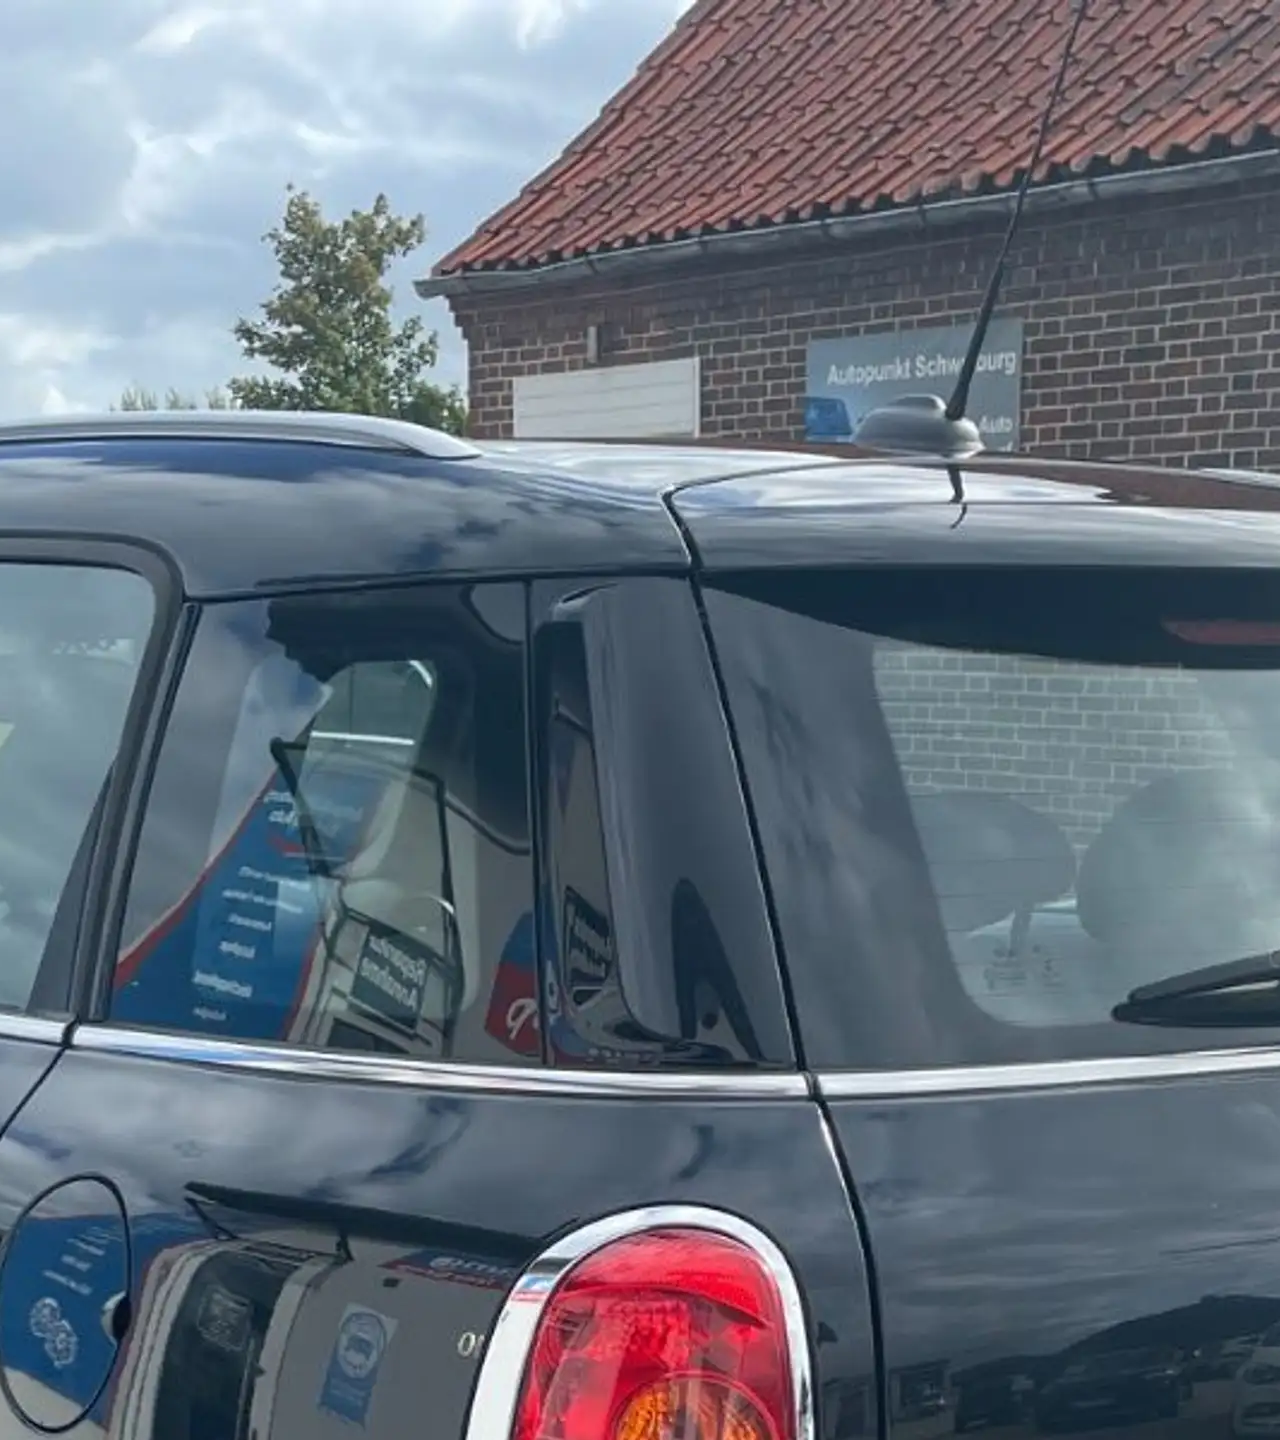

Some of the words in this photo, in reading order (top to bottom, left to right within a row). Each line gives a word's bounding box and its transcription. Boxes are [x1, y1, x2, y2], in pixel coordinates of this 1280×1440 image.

[826, 355, 911, 387] Autopunkt
[914, 350, 1017, 379] Schwburg
[978, 415, 1014, 434] Auto
